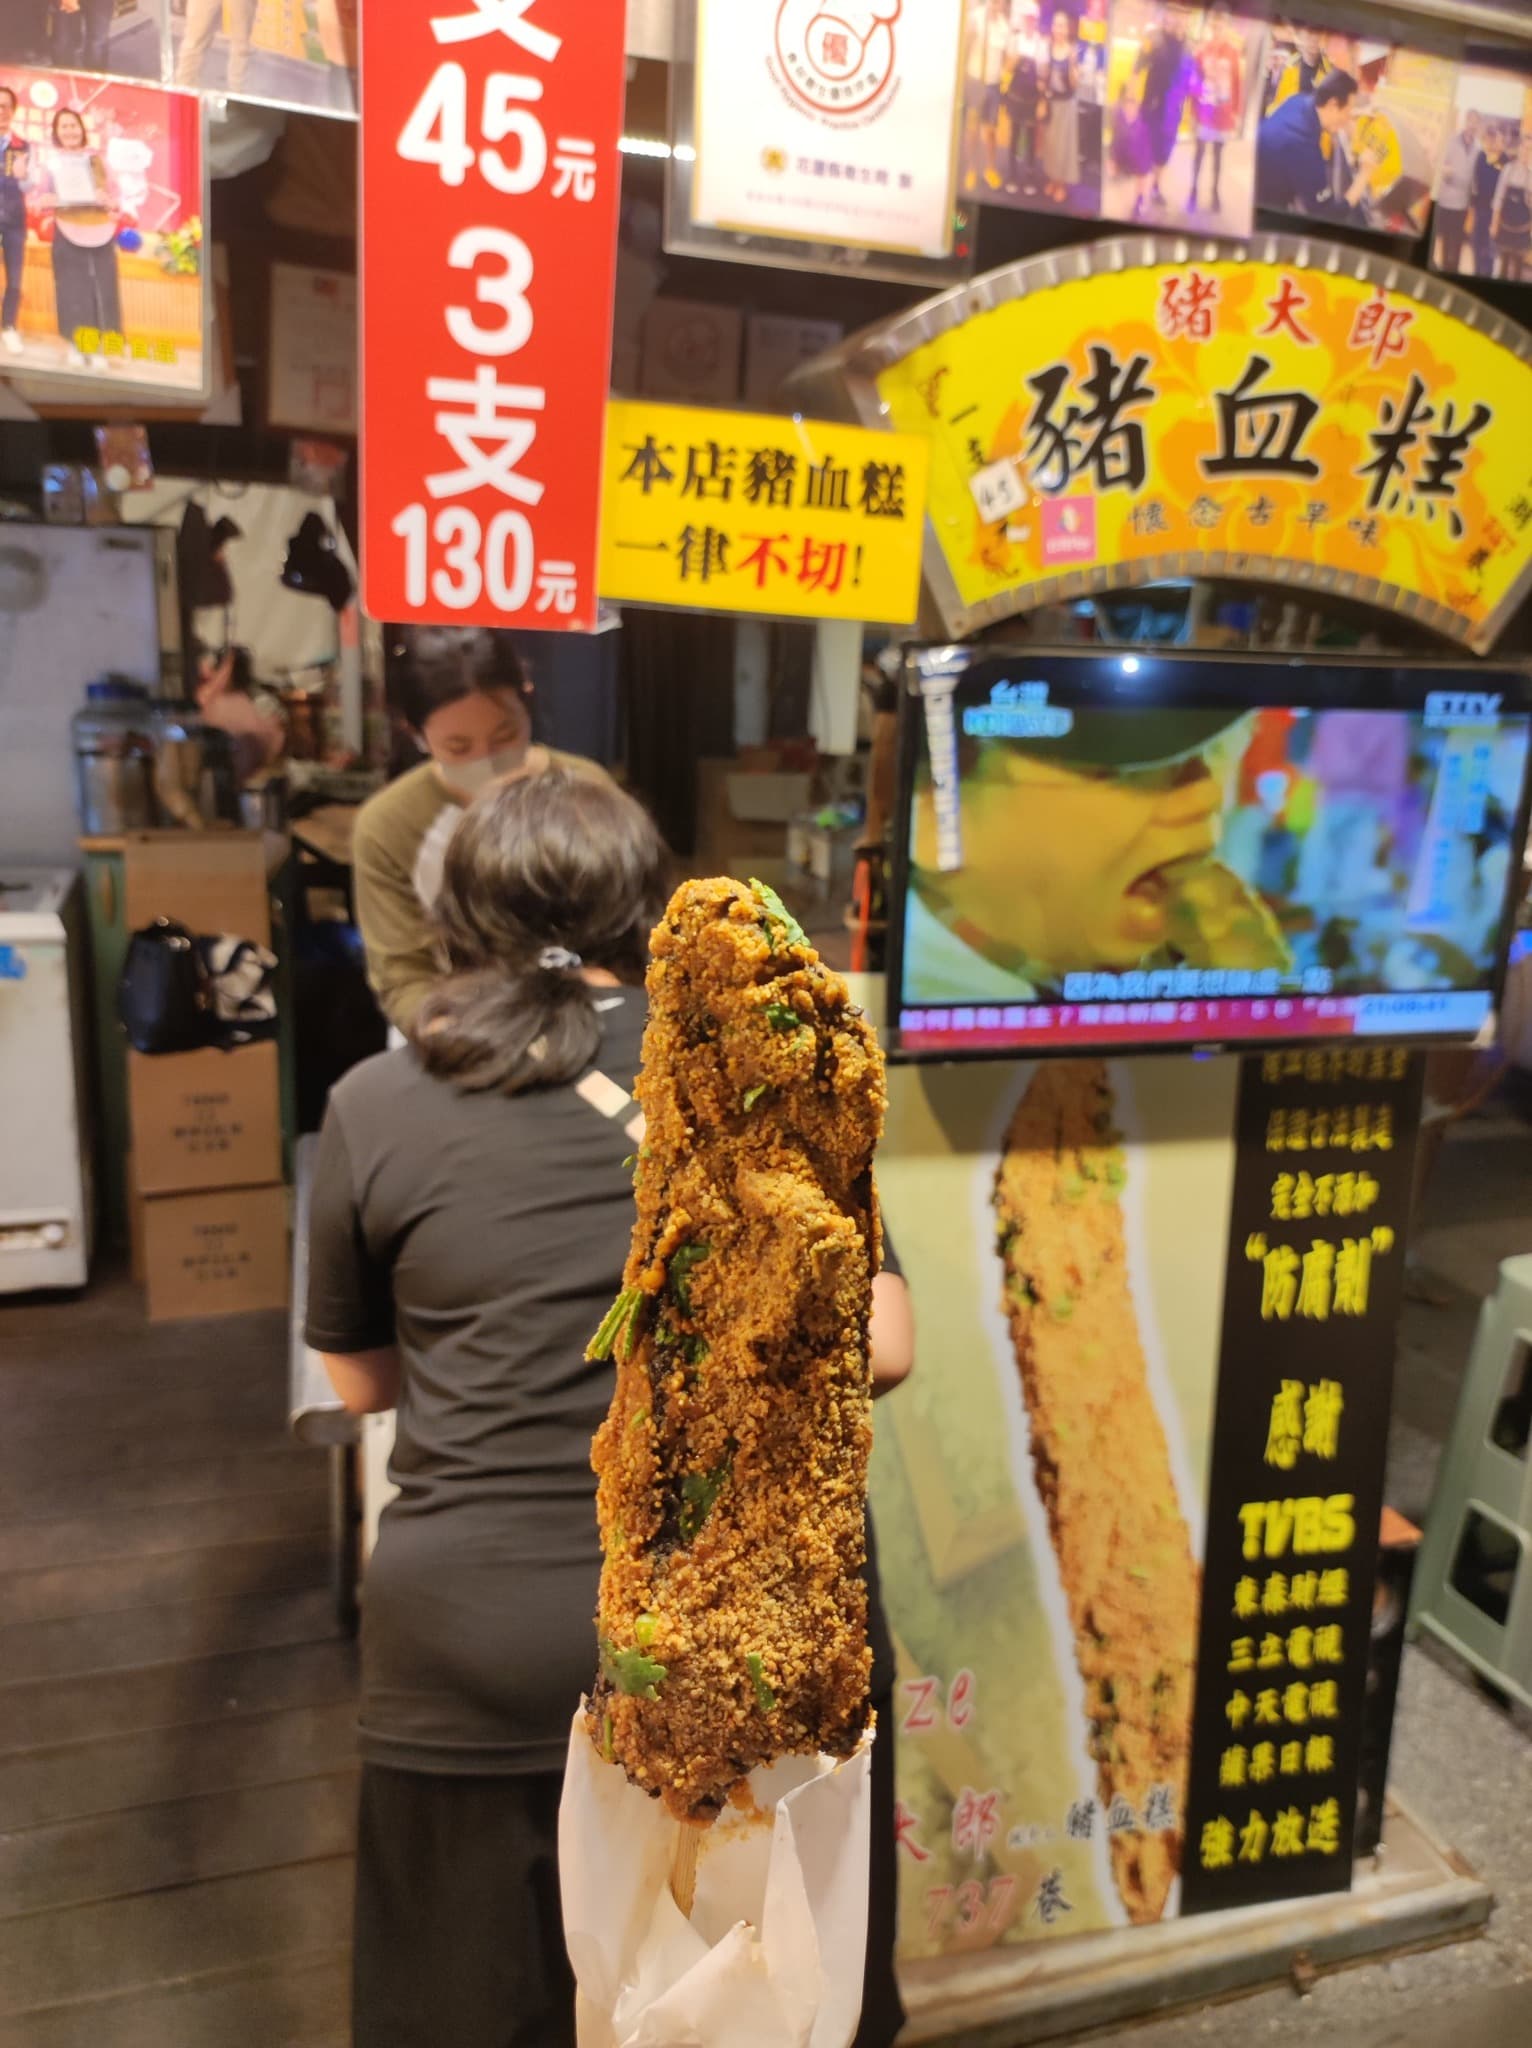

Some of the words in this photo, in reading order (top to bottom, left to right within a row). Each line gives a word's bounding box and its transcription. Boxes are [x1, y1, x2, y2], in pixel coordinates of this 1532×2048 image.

[397, 61, 597, 202] 45元
[444, 226, 534, 356] 3
[1157, 270, 1415, 365] 豬大郎
[424, 364, 546, 506] 支
[619, 434, 906, 520] 本店豬血糕
[1025, 345, 1492, 539] 豬血糕
[391, 502, 577, 613] 130元
[614, 523, 864, 594] 一律不切!
[1129, 495, 1381, 547] 懷念古早味
[1264, 1379, 1344, 1470] 感謝
[1238, 1493, 1356, 1560] TVBS
[1226, 1623, 1344, 1673] 三立電視
[1225, 1679, 1340, 1729] 中天電視
[1200, 1796, 1341, 1869] 強力放送
